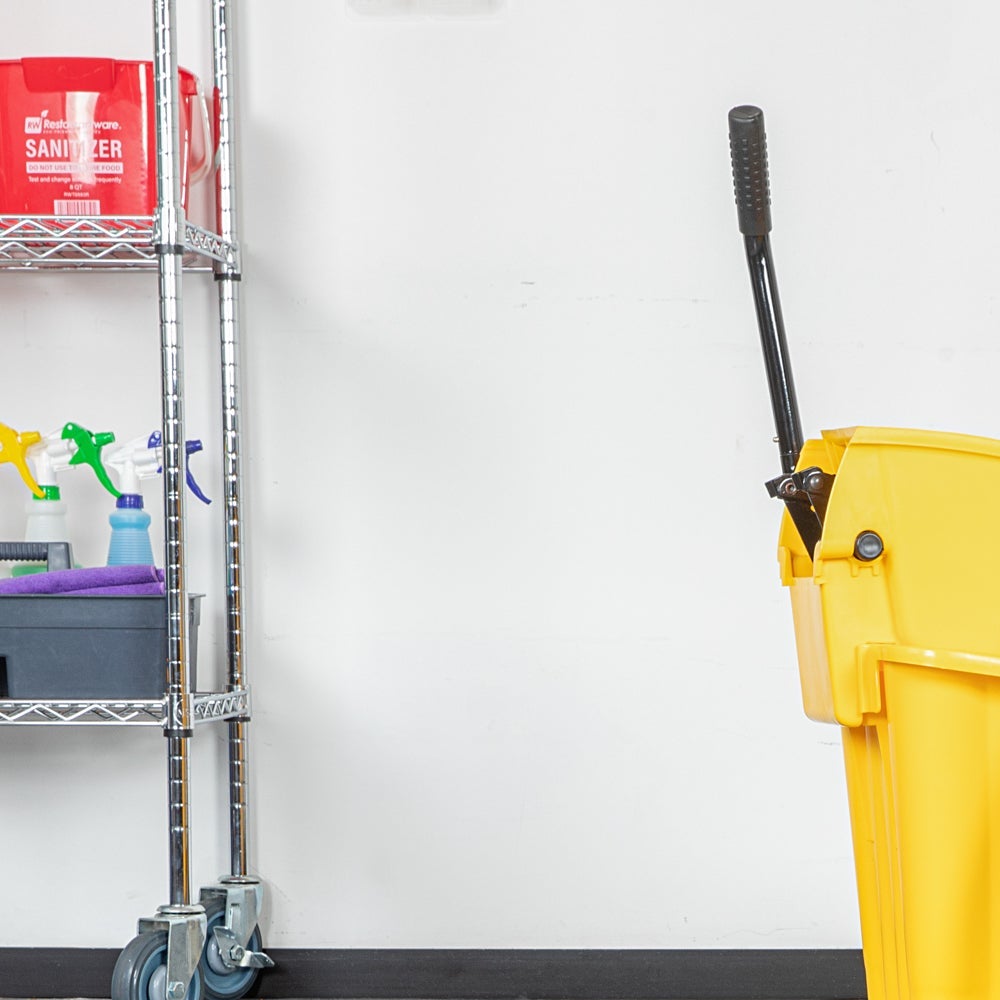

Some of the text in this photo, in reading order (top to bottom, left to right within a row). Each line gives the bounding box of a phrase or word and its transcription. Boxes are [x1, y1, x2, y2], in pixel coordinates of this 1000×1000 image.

[25, 138, 123, 158] SANITIZER
[28, 163, 38, 172] DO
[39, 163, 53, 172] NOT
[54, 163, 67, 172] USE
[101, 163, 121, 172] FOOD
